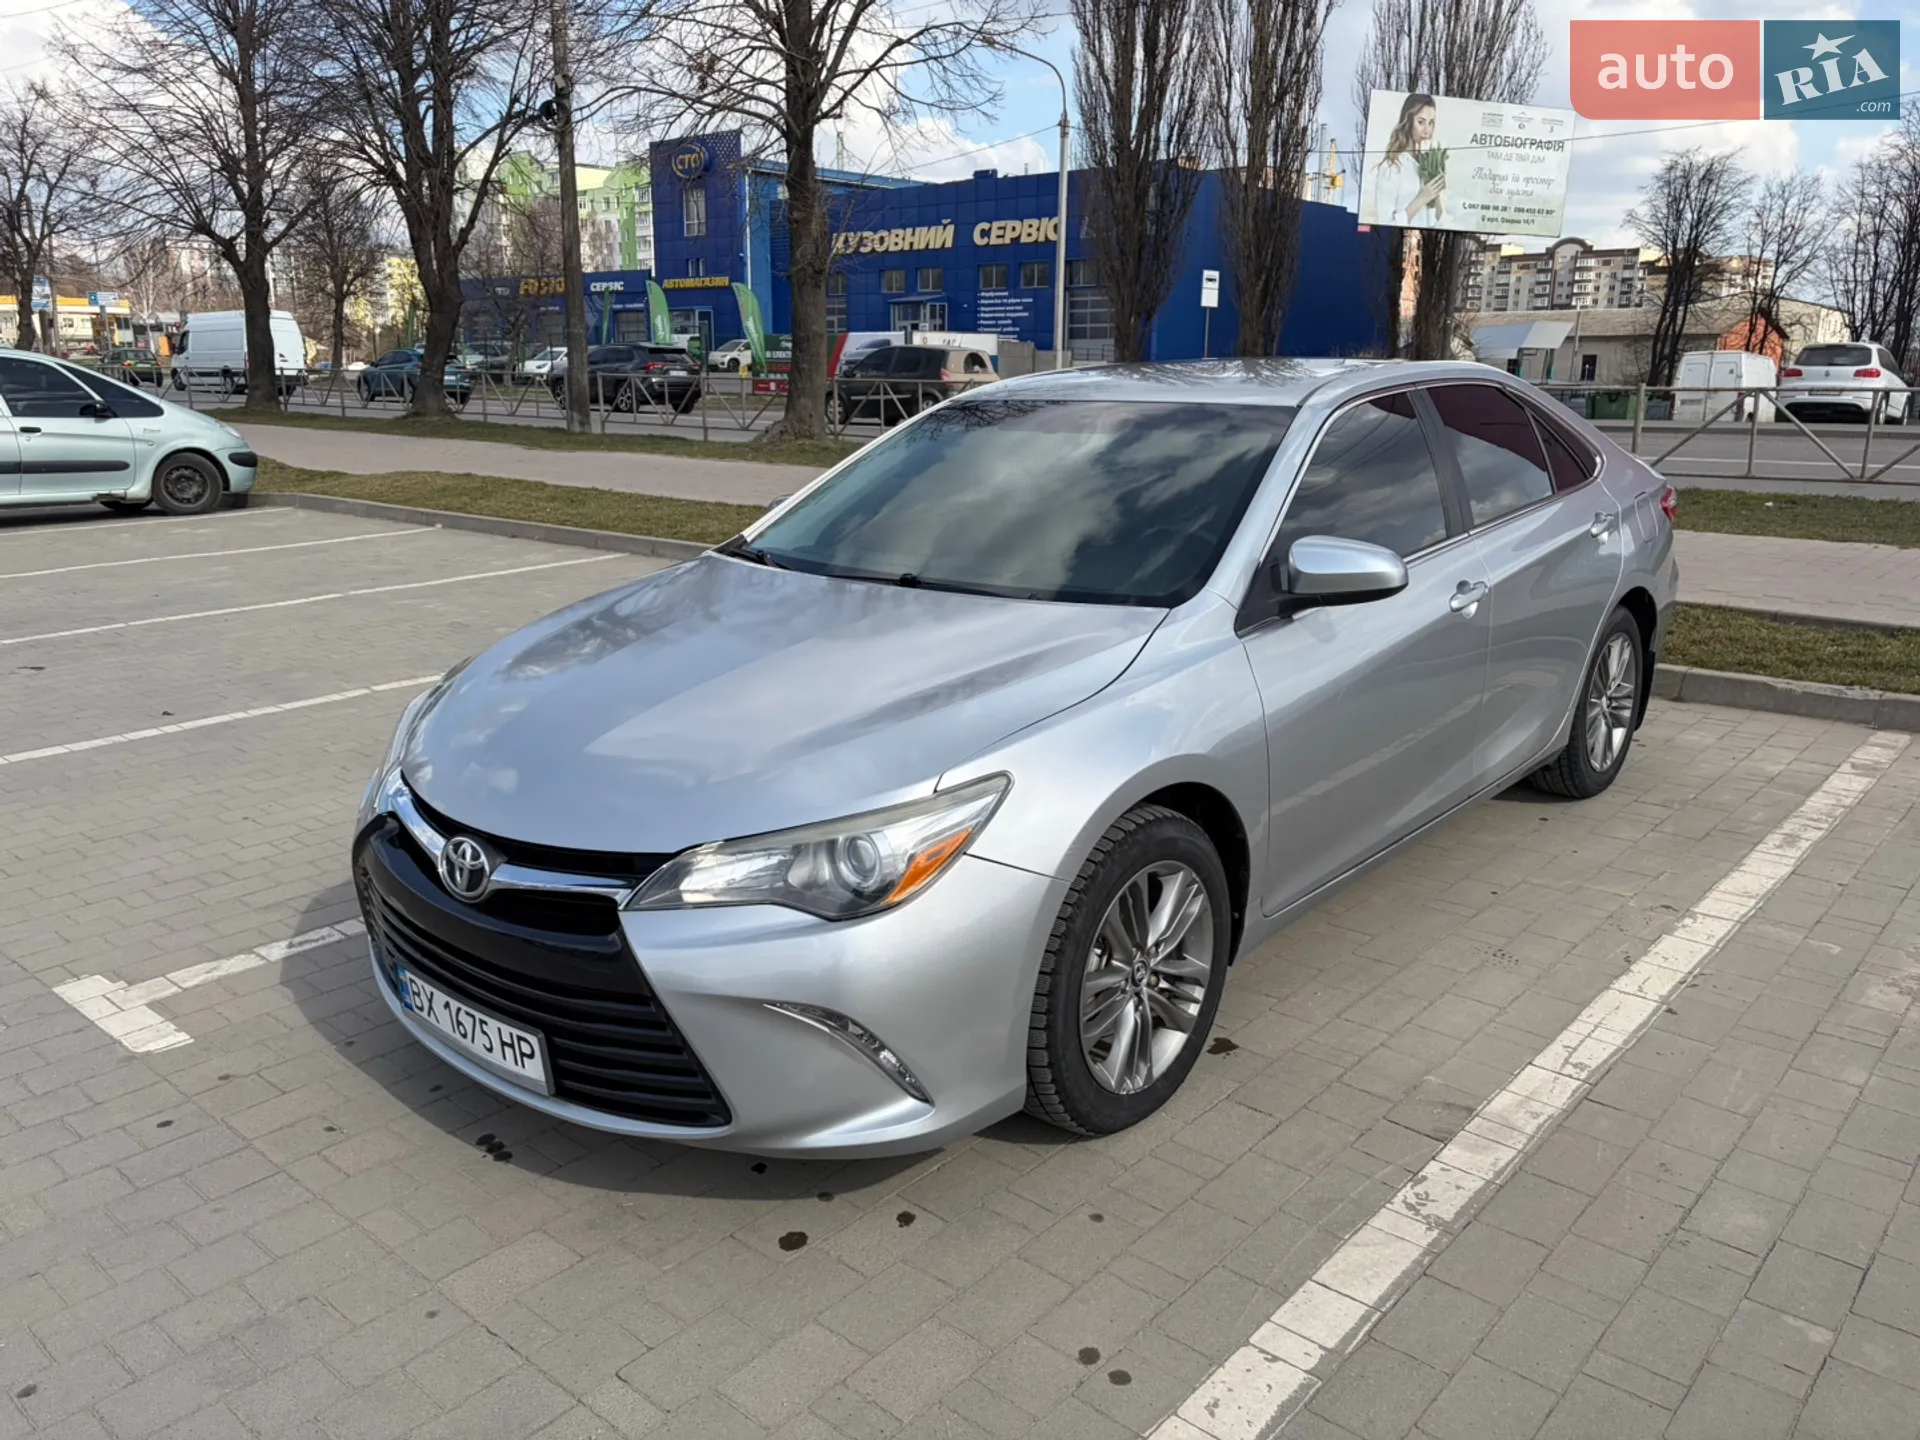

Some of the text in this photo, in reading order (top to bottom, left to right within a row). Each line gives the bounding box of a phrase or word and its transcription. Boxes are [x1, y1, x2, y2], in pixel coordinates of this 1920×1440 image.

[1469, 133, 1565, 152] АВТОБІОГРАФІЯ
[676, 153, 701, 169] СТО
[1472, 166, 1508, 184] Подаруй
[831, 219, 954, 254] КУЗОВНИЙ
[662, 276, 729, 289] АВТОМАГАЗИН
[408, 977, 536, 1070] BX 1675 HP
